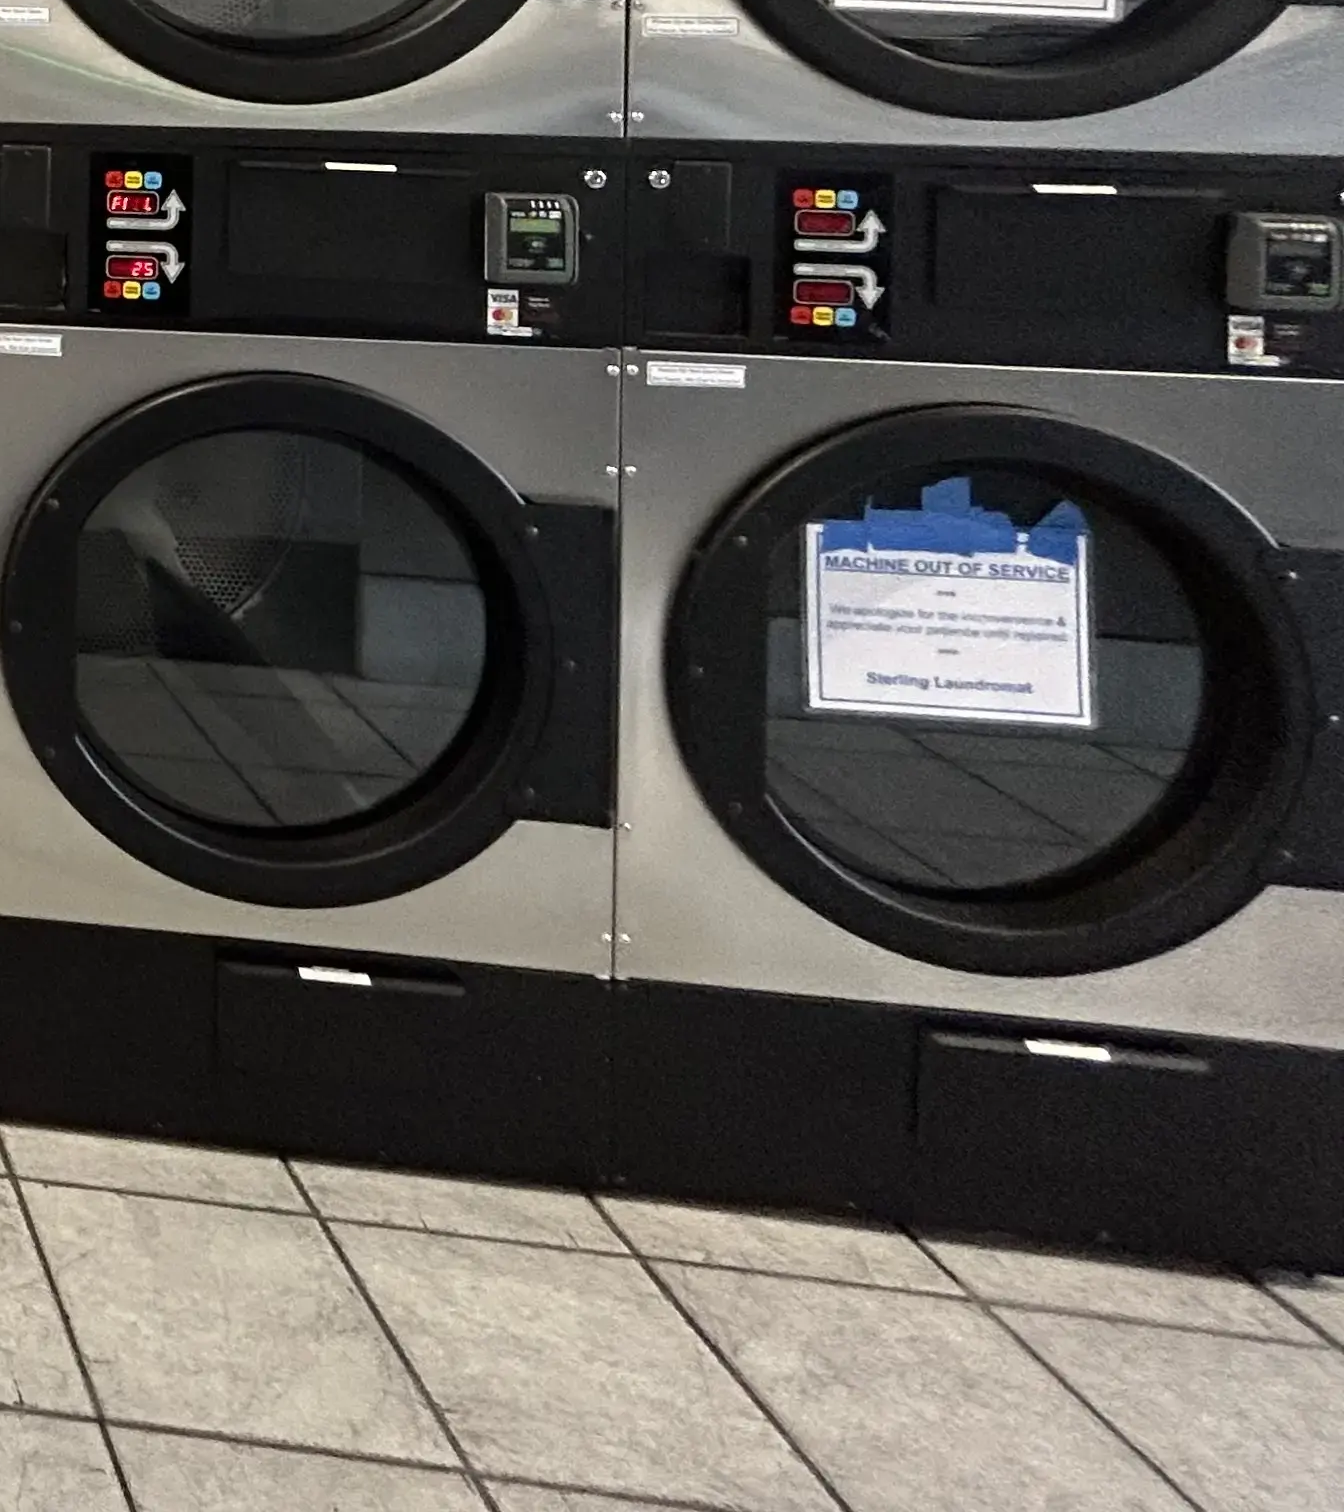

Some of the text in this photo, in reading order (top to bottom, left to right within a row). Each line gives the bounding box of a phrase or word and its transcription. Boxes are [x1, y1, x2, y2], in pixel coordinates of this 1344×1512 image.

[111, 194, 152, 212] FIL
[130, 261, 154, 277] 25
[824, 555, 1071, 581] MACHINE OUT OF SERVICE
[866, 671, 1034, 694] Sterling Laundromat
